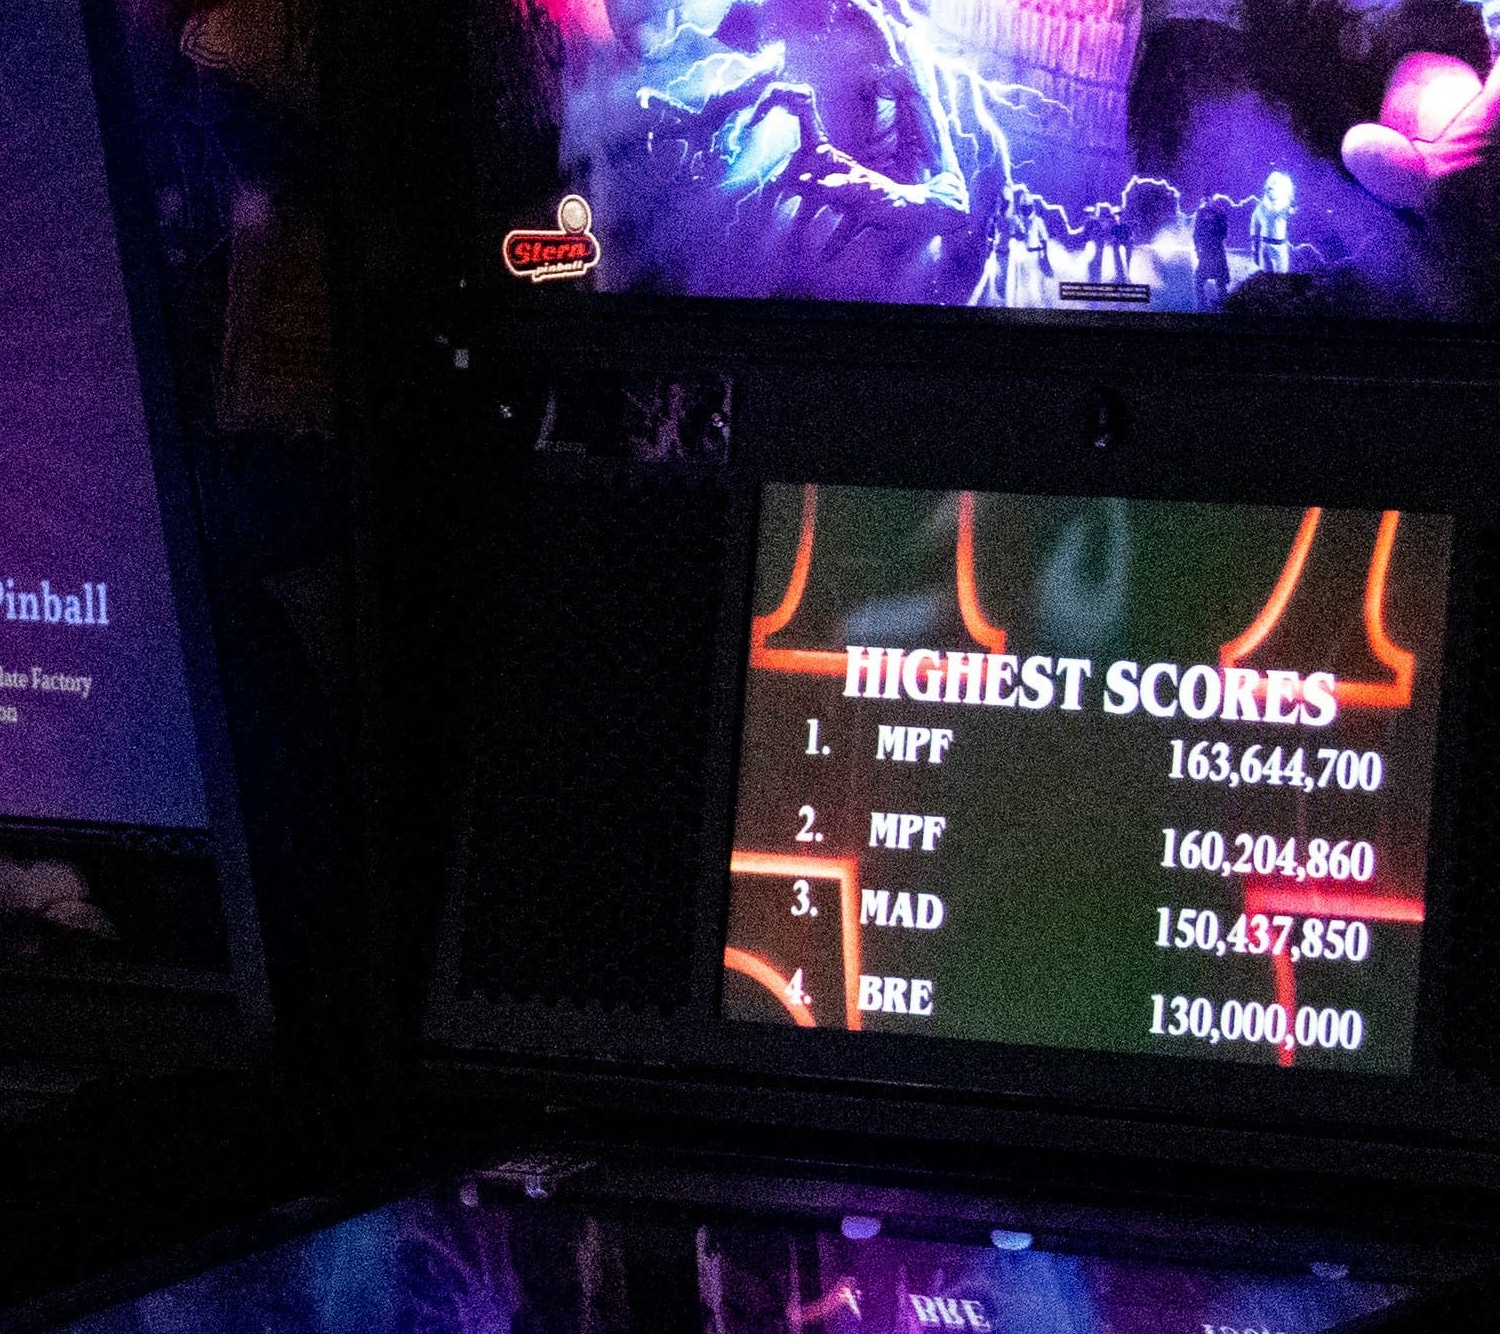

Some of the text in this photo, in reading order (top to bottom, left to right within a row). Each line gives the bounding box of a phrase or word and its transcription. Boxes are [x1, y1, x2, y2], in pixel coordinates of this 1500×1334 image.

[513, 242, 587, 266] Stern
[535, 261, 584, 276] pinball
[31, 667, 93, 698] Factory
[842, 643, 1339, 728] HIGHEST SCORES
[804, 717, 1384, 795] 1. MPF 163,644,700
[797, 805, 1376, 884] 2. MPF 160,204,860
[790, 878, 1371, 963] 3. MAD 150,437,850
[783, 968, 1365, 1052] 4. BRE 130,000,000
